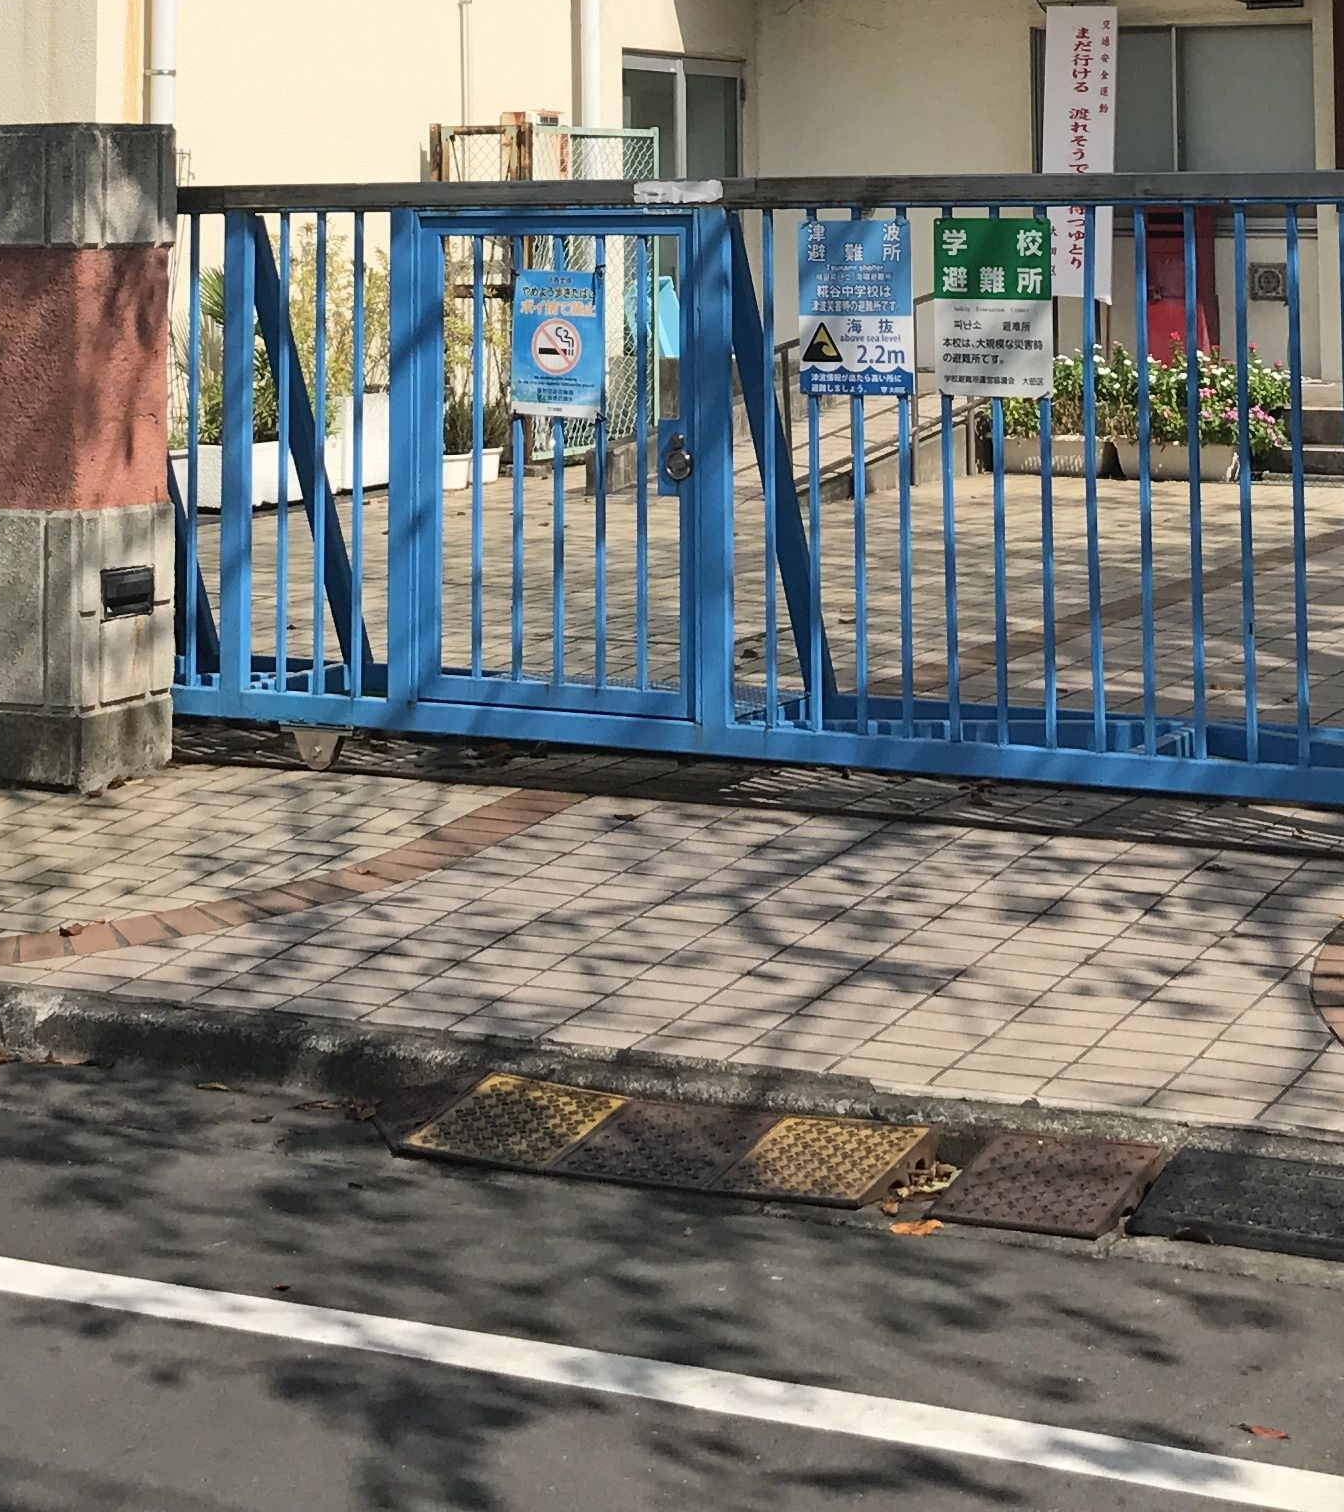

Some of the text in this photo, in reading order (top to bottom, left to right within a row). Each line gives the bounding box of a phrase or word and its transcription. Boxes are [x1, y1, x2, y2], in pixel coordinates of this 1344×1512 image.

[1068, 27, 1094, 174] まだ行ける 渡れそうで
[807, 222, 901, 242] 津波
[807, 243, 902, 262] 避難所
[942, 229, 1043, 257] 学校
[942, 266, 1043, 294] 避難所
[816, 285, 892, 298] 糀谷中学校は
[847, 318, 894, 334] 海抜
[840, 334, 902, 343] above sea level
[943, 337, 1044, 350] 本校は、大規模な災害時
[856, 344, 906, 364] 2.2m
[942, 353, 1005, 365] の避難所です。
